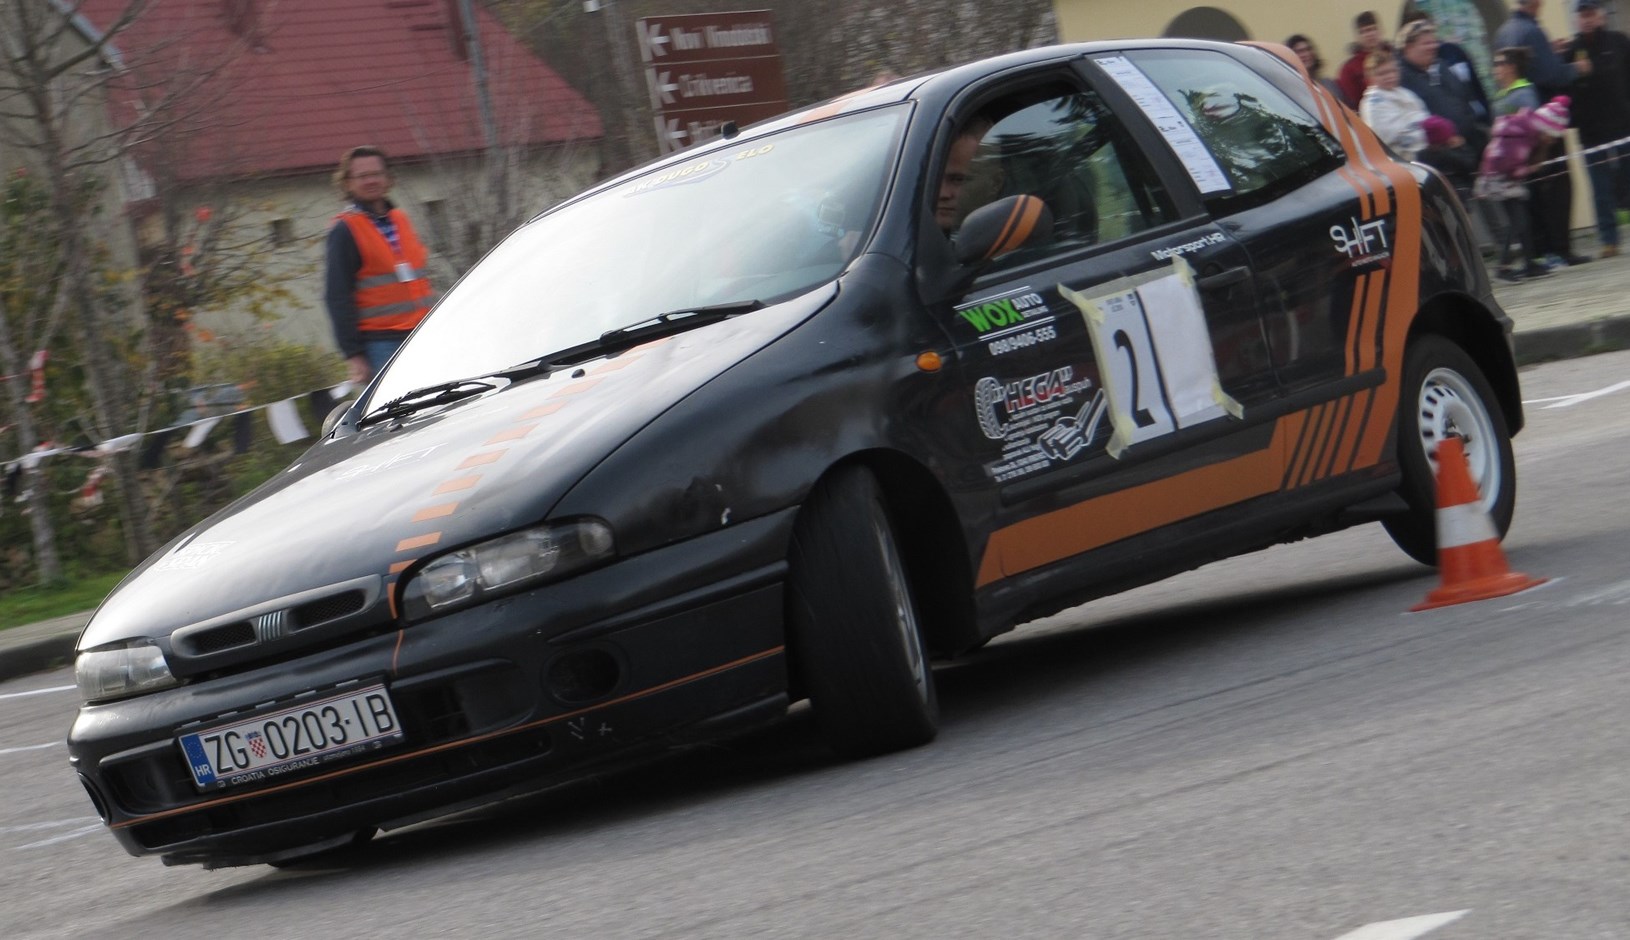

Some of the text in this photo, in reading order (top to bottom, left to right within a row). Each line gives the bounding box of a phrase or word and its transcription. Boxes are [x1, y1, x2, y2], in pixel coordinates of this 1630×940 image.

[1329, 216, 1388, 258] SHIFT
[959, 293, 1043, 332] WOX AUTO
[194, 762, 212, 777] HR
[204, 730, 250, 774] ZG
[231, 770, 265, 786] CROATIA
[267, 756, 320, 776] OSIGURANJE
